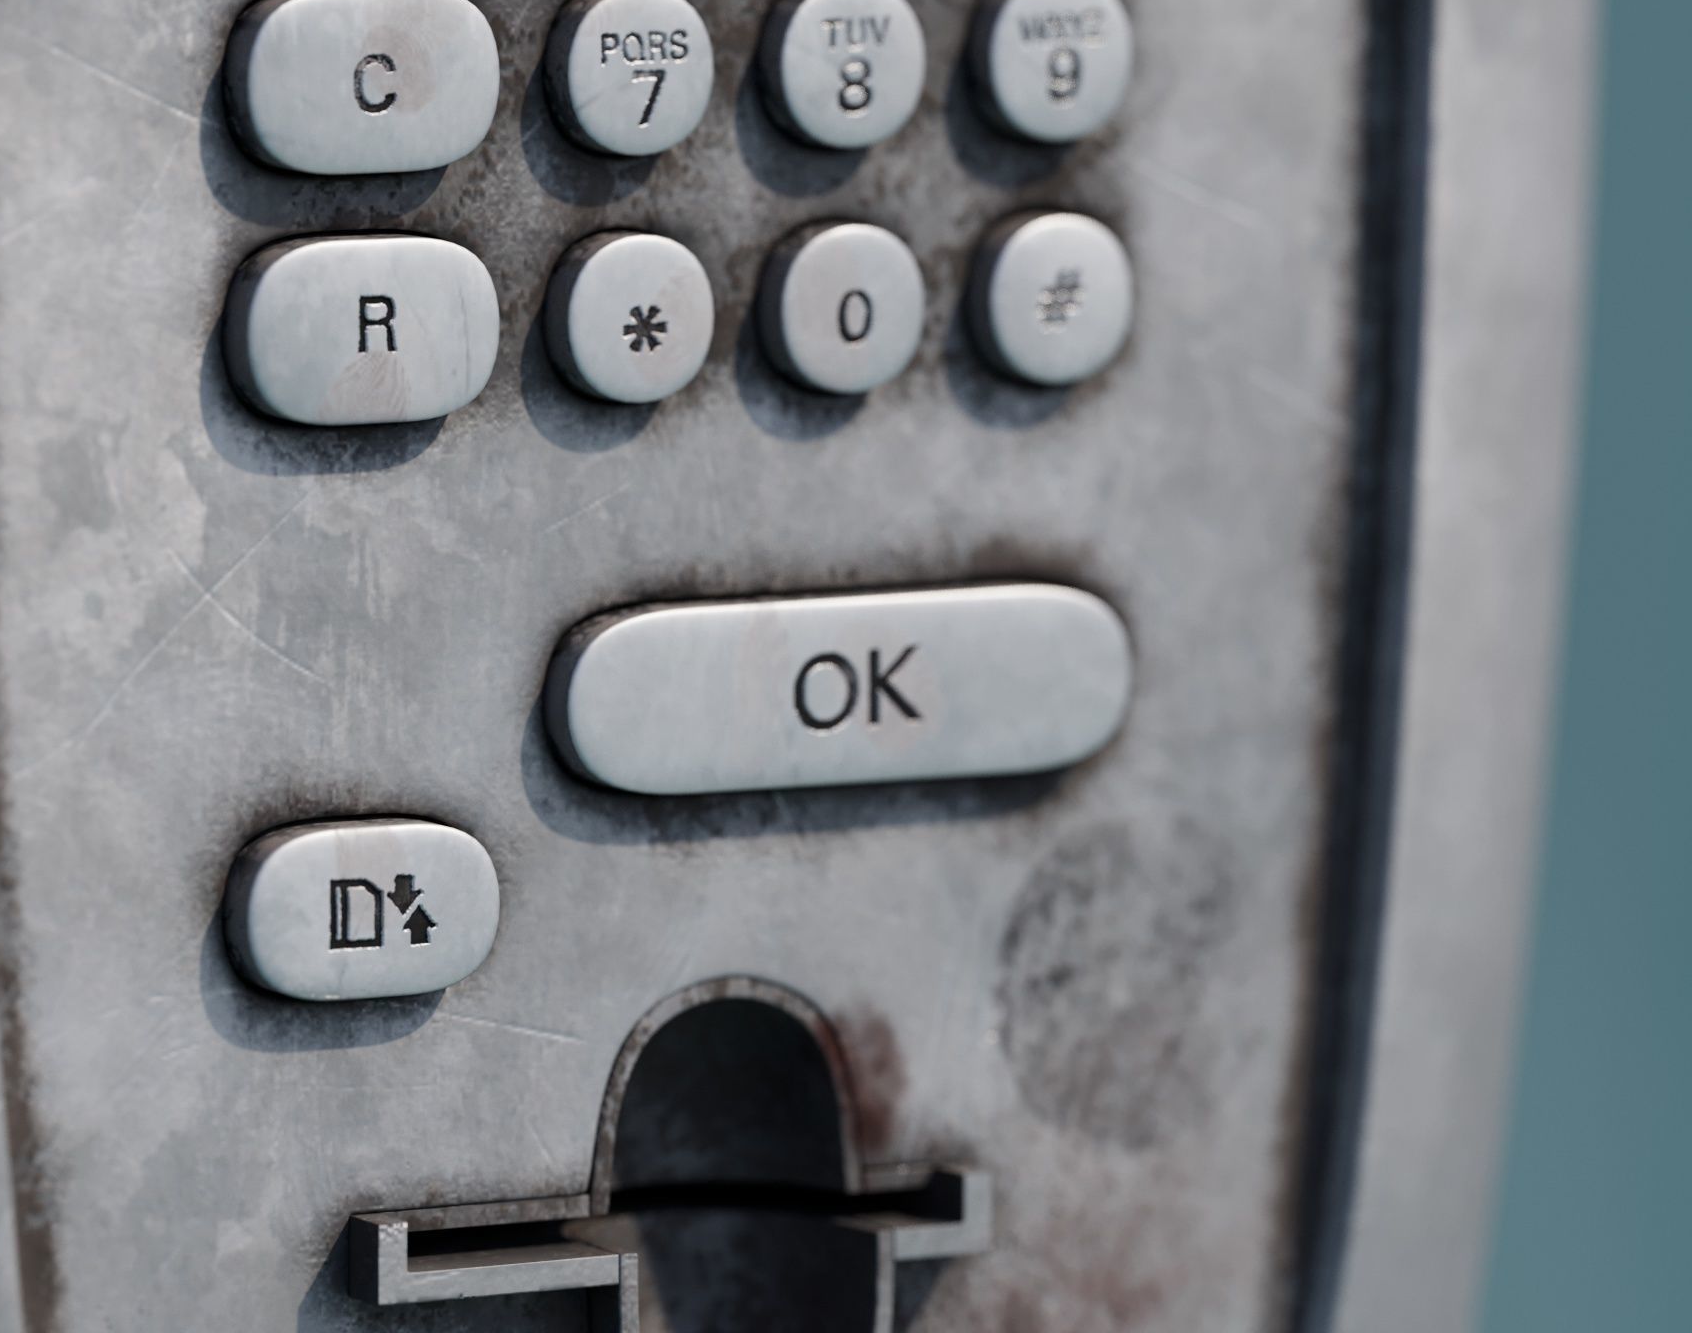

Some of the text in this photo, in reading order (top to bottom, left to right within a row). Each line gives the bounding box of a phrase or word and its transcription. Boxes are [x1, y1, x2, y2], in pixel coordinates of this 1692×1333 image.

[599, 29, 689, 65] PQRS
[821, 15, 891, 50] TUV
[352, 54, 397, 115] C
[631, 70, 666, 128] 7
[838, 56, 873, 116] 8
[1046, 47, 1081, 104] 9
[357, 294, 398, 354] R
[792, 643, 922, 731] OK
